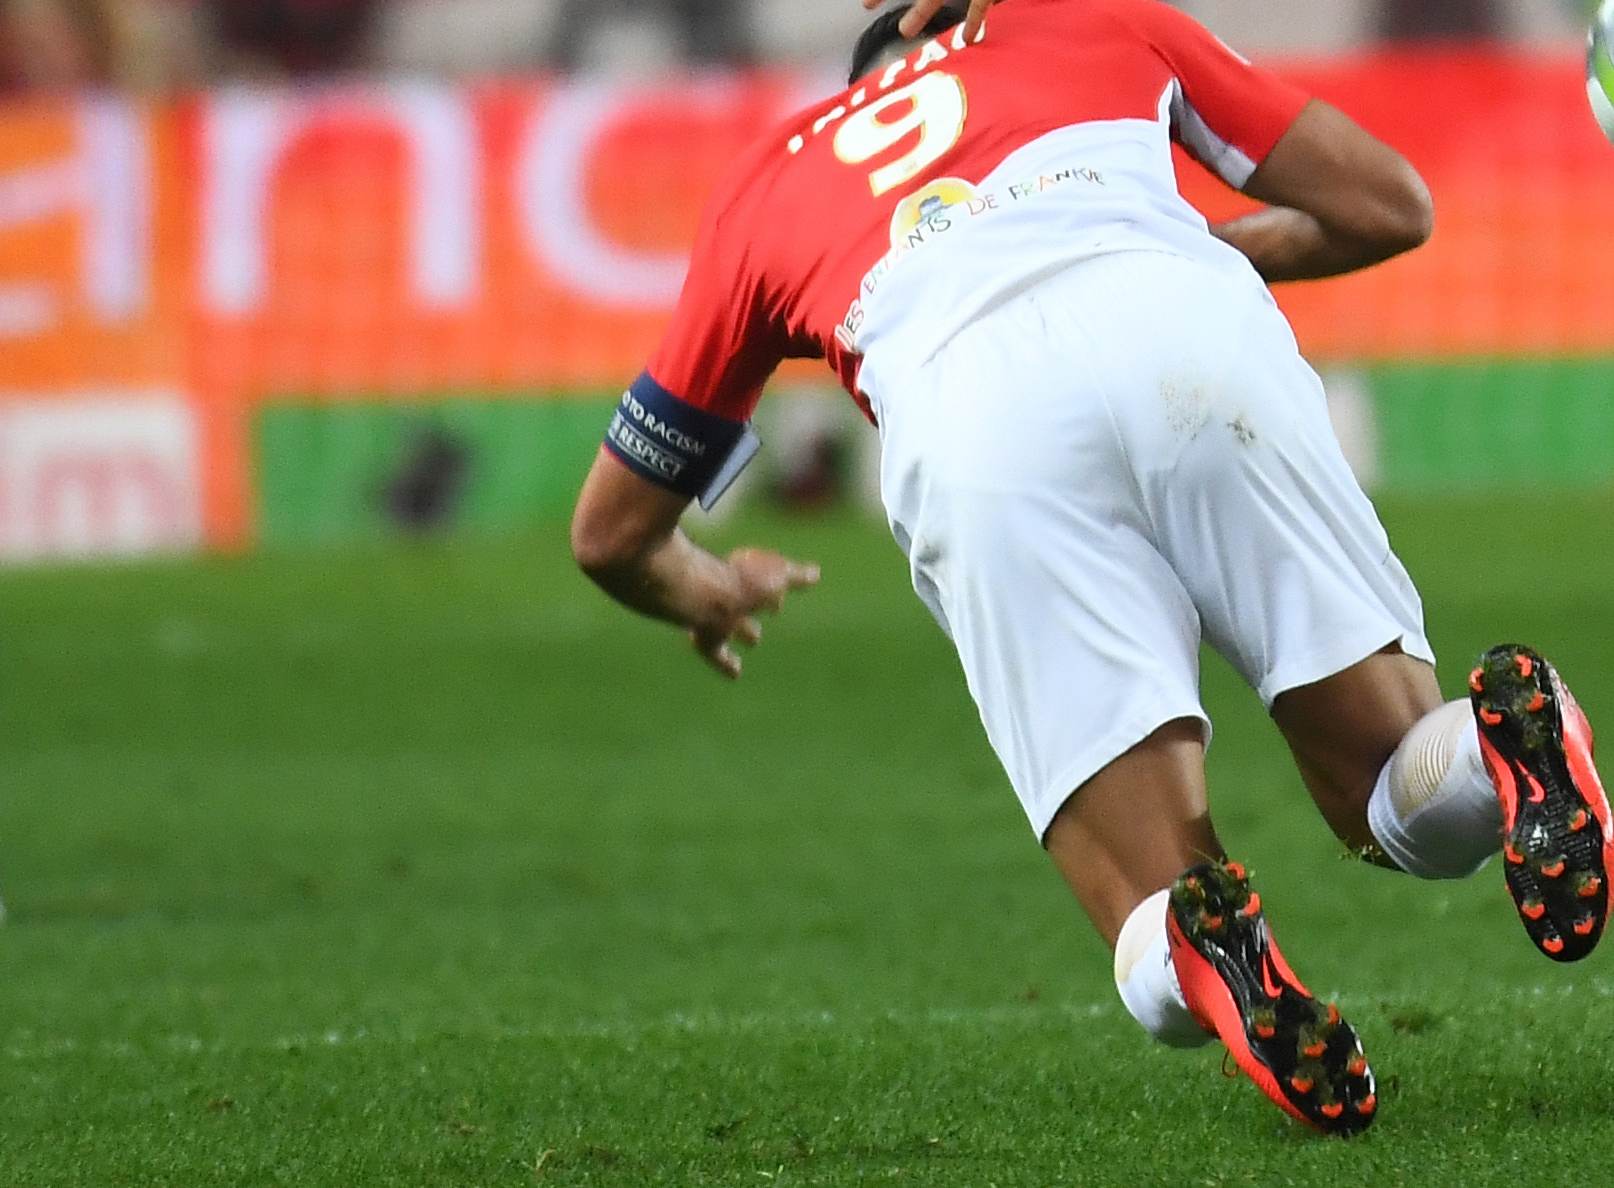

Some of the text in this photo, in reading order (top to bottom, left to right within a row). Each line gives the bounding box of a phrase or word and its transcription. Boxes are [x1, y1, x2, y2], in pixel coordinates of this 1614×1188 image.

[832, 68, 968, 199] 9
[966, 193, 999, 216] DE
[628, 398, 645, 421] TO
[617, 426, 683, 477] RESPECT
